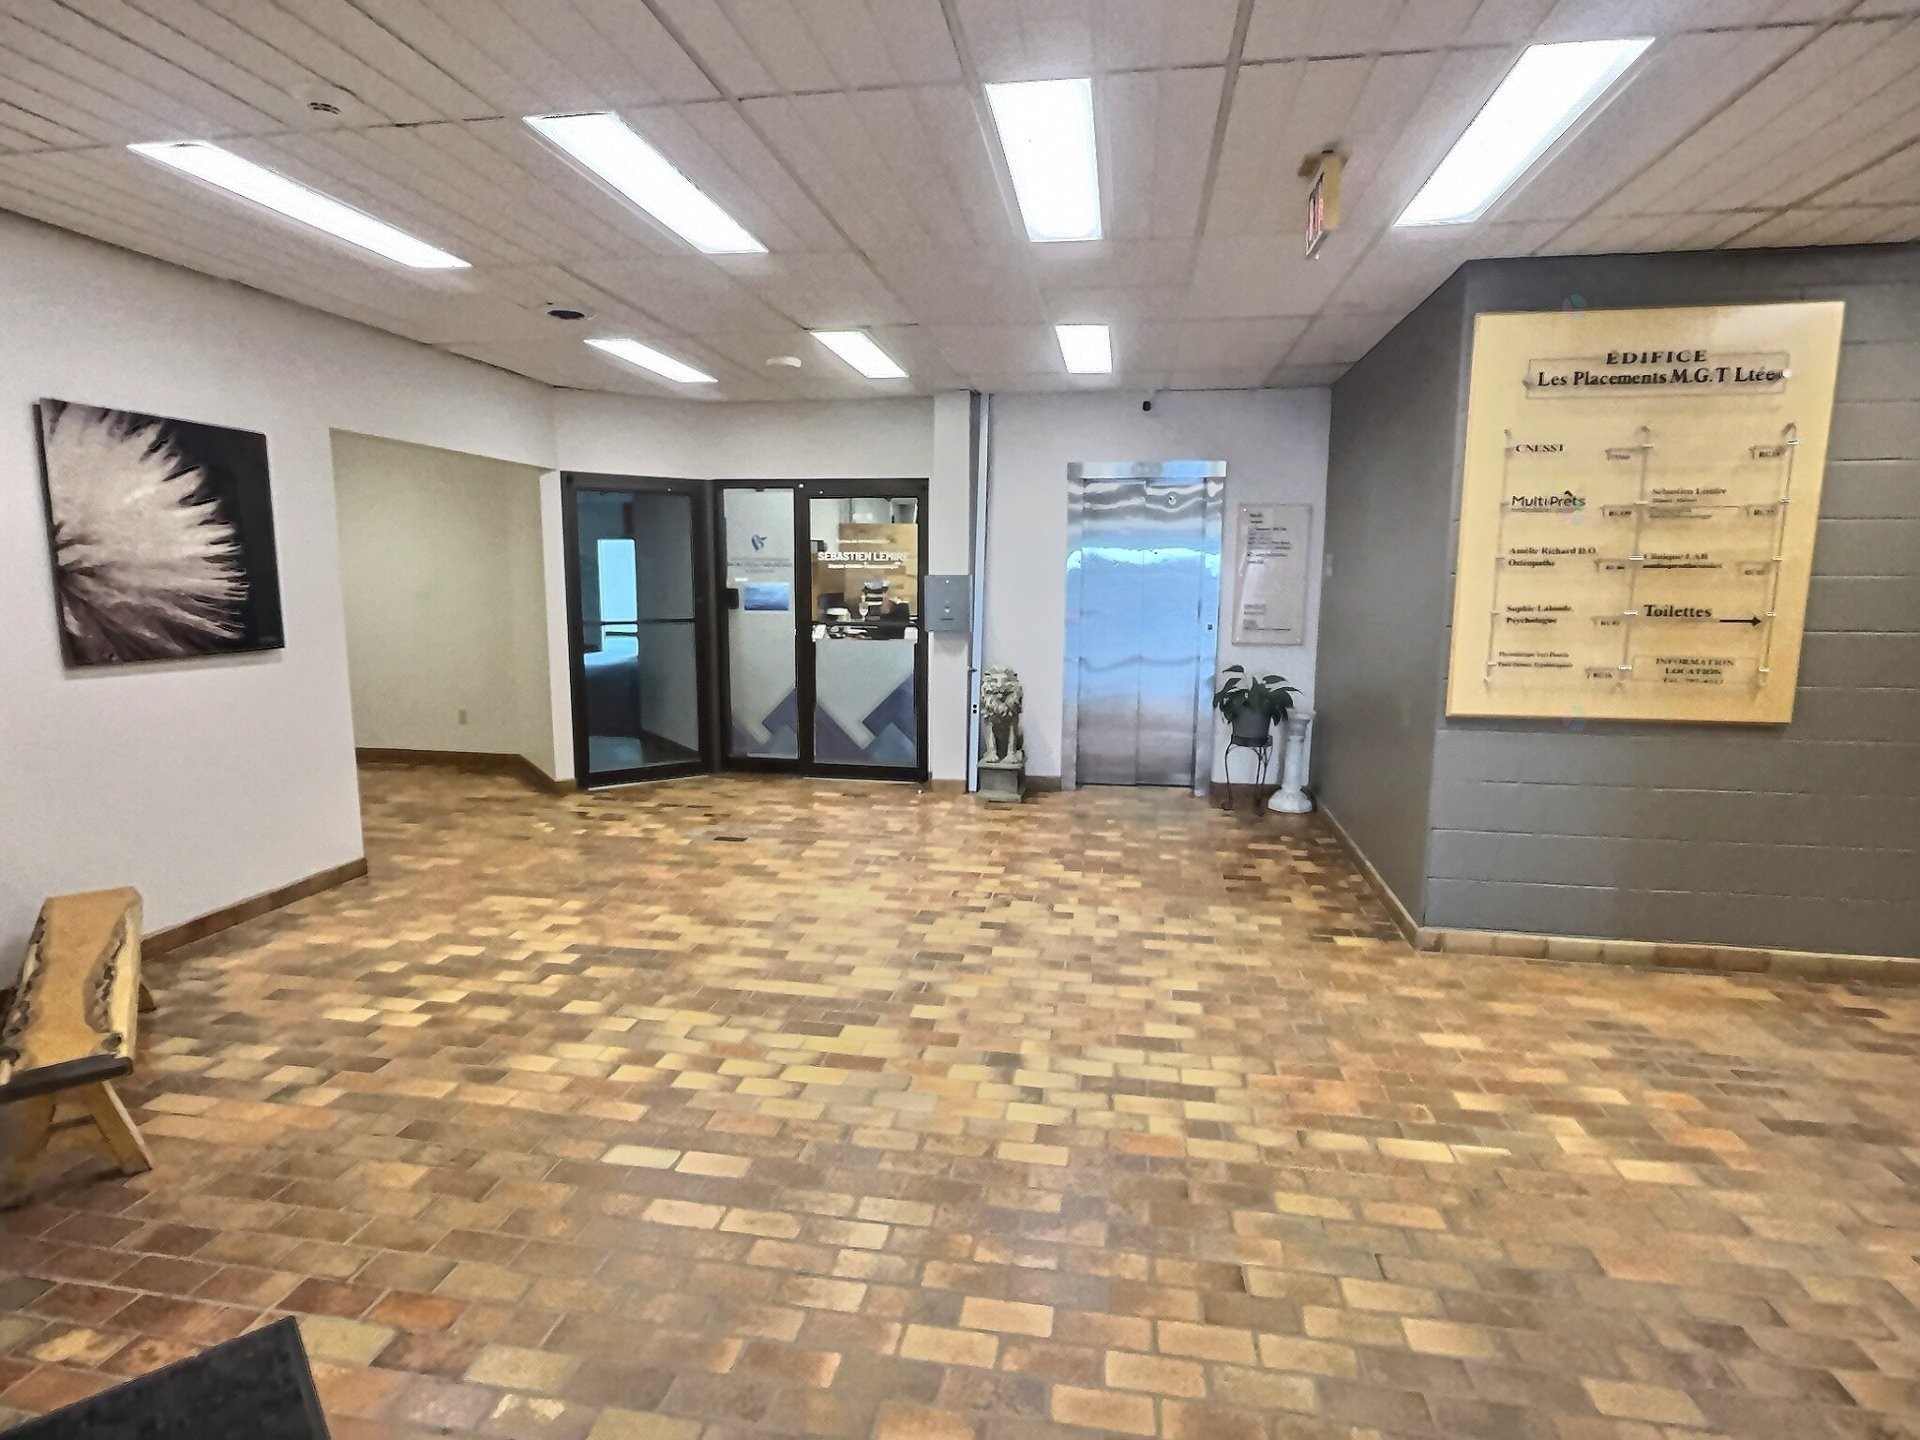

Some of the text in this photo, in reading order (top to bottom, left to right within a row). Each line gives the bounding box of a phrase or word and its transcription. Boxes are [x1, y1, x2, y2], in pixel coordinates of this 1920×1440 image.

[1538, 371, 1567, 387] Les
[1573, 370, 1666, 387] Placements
[1644, 604, 1713, 618] Toilettes
[1655, 658, 1734, 666] INFORMATION
